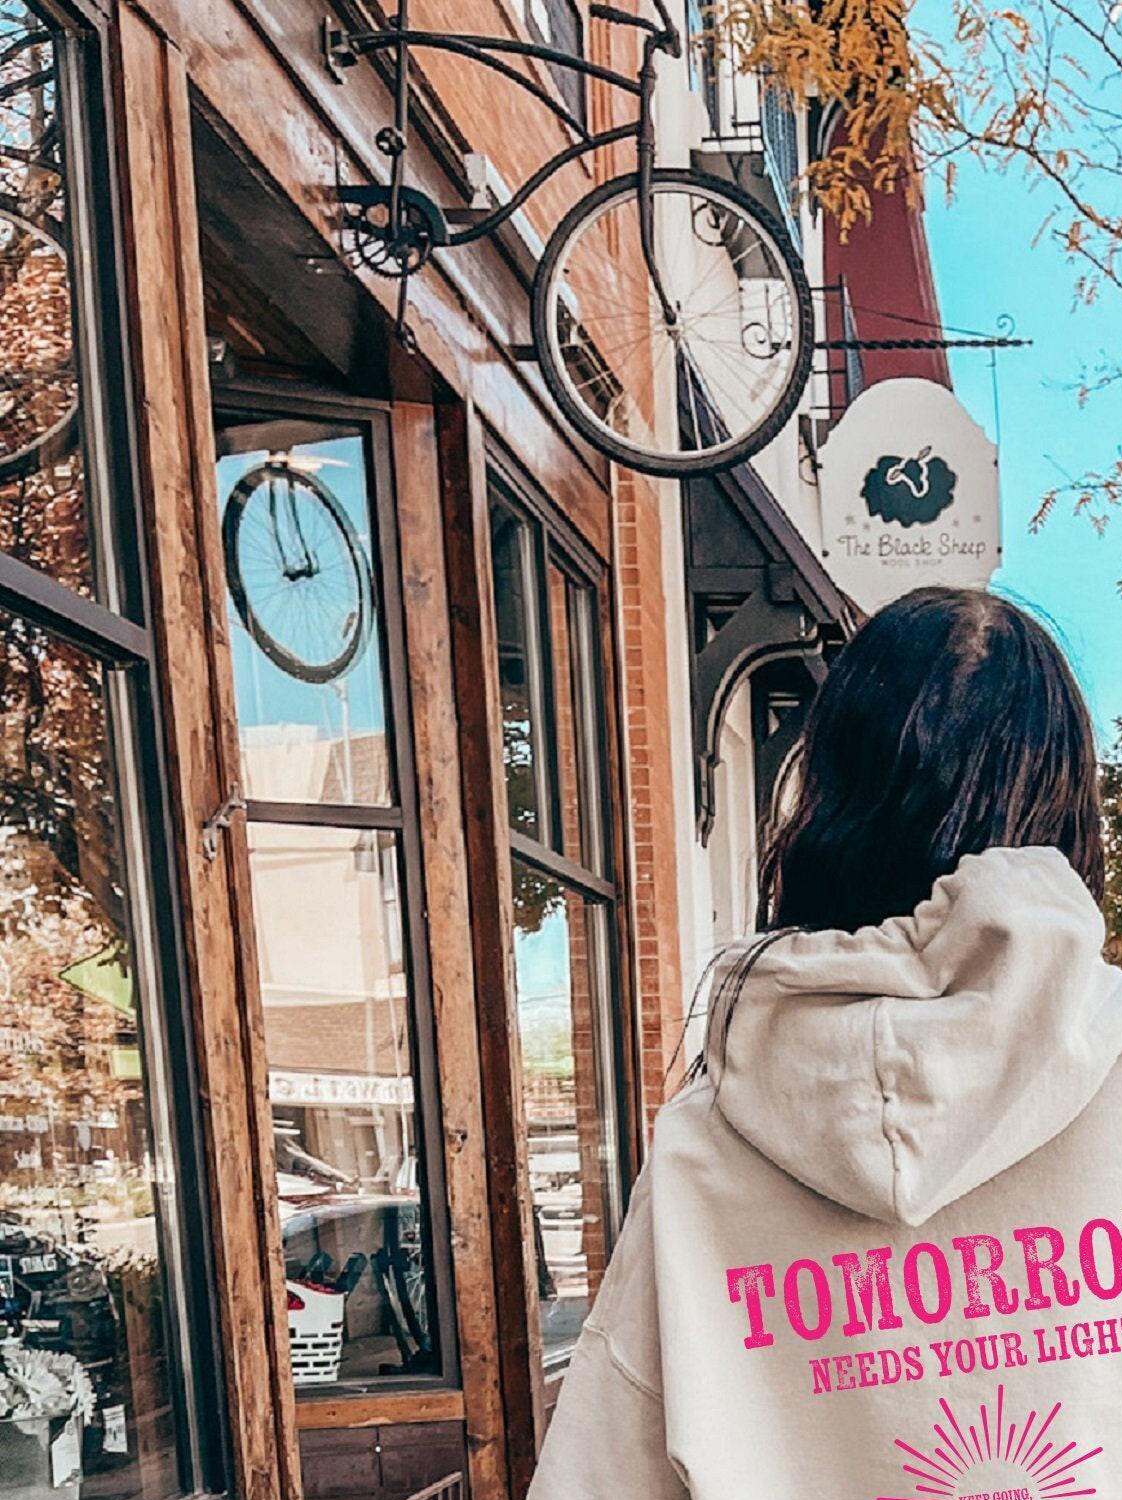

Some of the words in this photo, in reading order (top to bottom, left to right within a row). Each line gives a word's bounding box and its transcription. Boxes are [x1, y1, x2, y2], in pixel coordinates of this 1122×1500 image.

[838, 534, 870, 557] The
[878, 533, 932, 557] Black
[938, 532, 986, 560] Sheep
[809, 1346, 924, 1395] NEEDS
[930, 1333, 1028, 1377] YOUR
